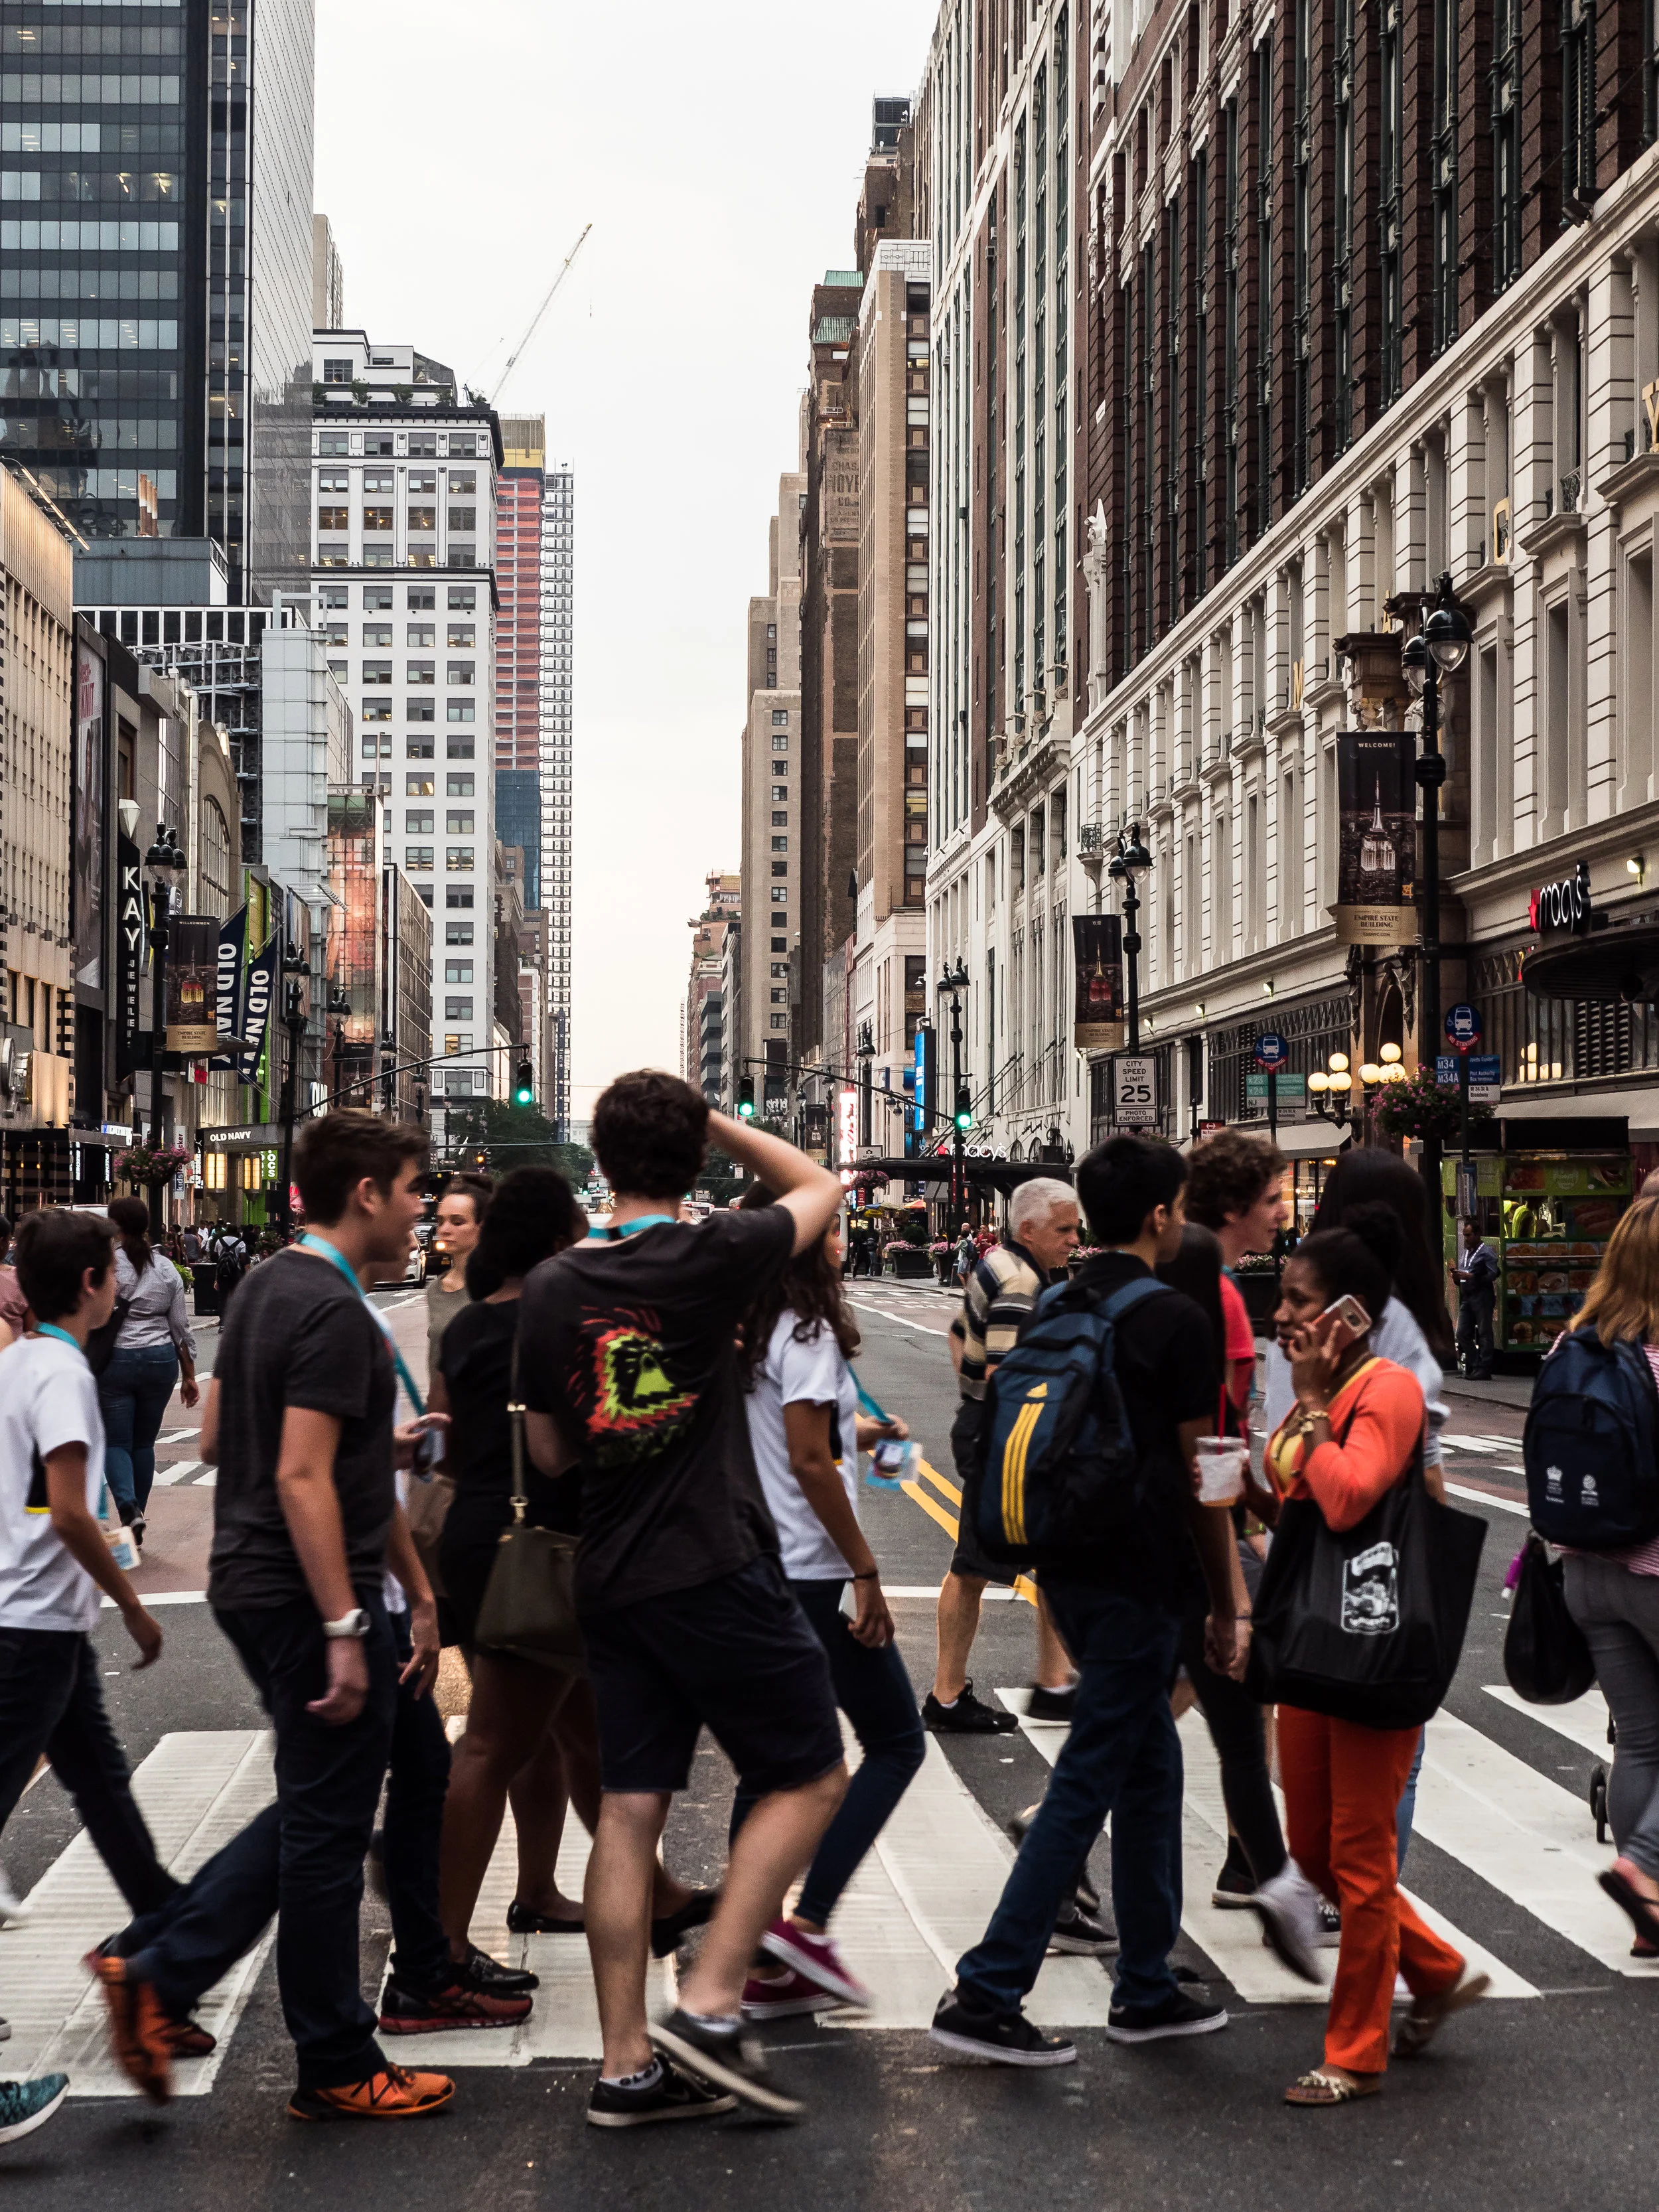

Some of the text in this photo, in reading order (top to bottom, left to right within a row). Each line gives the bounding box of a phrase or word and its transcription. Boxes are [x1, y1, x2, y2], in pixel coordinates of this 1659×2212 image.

[122, 866, 142, 952] KAY
[217, 943, 237, 991] OLD
[248, 970, 270, 1013] OLD
[1455, 1035, 1479, 1047] STANDING
[1437, 1059, 1454, 1069] M34
[1437, 1072, 1459, 1083] M34A
[1120, 1084, 1151, 1103] 25
[210, 1131, 252, 1142] OLD NAVY
[950, 1142, 1007, 1161] macy's
[176, 1173, 184, 1192] kids
